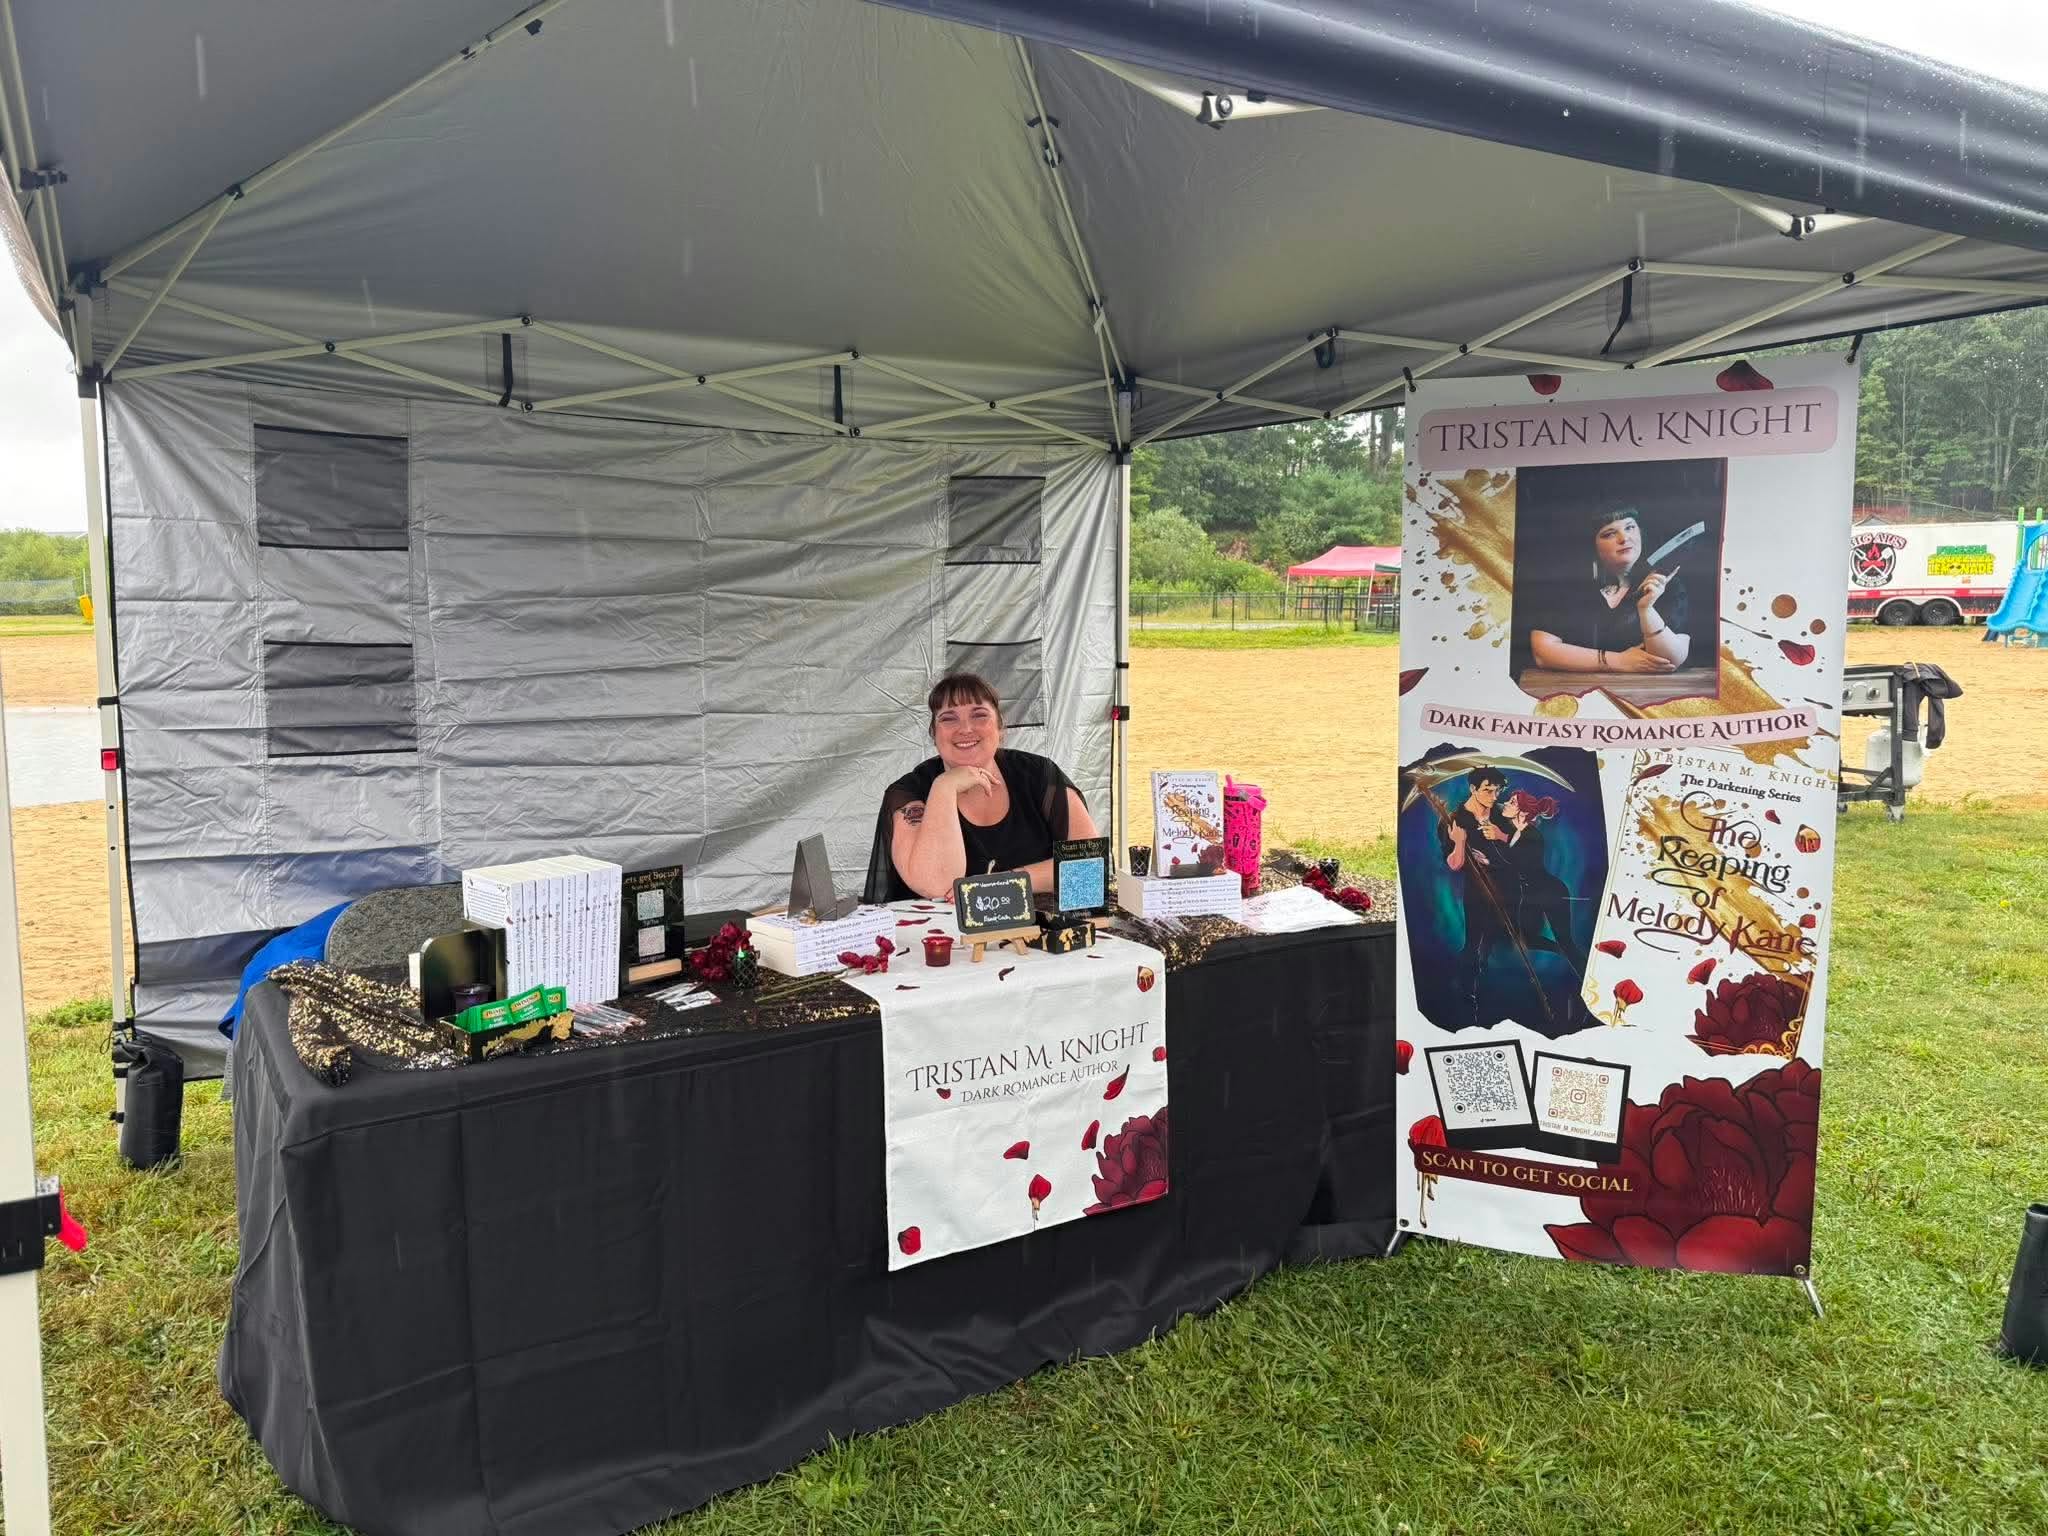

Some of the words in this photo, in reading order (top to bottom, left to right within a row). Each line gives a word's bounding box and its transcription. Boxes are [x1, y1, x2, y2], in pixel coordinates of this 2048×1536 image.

[1429, 416, 1590, 452] TRISTAN
[1599, 411, 1644, 448] M.
[1656, 402, 1822, 446] KNIGHT
[1427, 709, 1485, 732] DARK
[1491, 718, 1587, 740] FANTASY
[1593, 723, 1706, 744] ROMANCE
[1711, 711, 1809, 738] AUTHOR
[1654, 751, 1730, 773] TRISTAN
[1739, 766, 1755, 777] M.
[1768, 771, 1838, 791] KNIGHT
[1681, 773, 1704, 788] The
[1707, 778, 1766, 799] Darkening
[1768, 789, 1802, 803] Series
[1681, 791, 1762, 849] The
[1651, 835, 1794, 906] Reaping
[1692, 886, 1728, 910] of
[1607, 893, 1726, 953] Melody
[1728, 914, 1818, 957] Kane
[906, 1050, 1018, 1092] TRISTAN
[1024, 1045, 1052, 1069] M.
[1060, 1021, 1149, 1063] KNIGHT
[960, 1082, 1002, 1102] DARK
[1003, 1071, 1067, 1095] ROMANCE
[1070, 1060, 1119, 1081] AUTHOR
[1423, 1151, 1475, 1171] SCAN
[1480, 1161, 1507, 1177] TO
[1513, 1166, 1552, 1184] GET
[1557, 1172, 1633, 1192] SOCIAL
